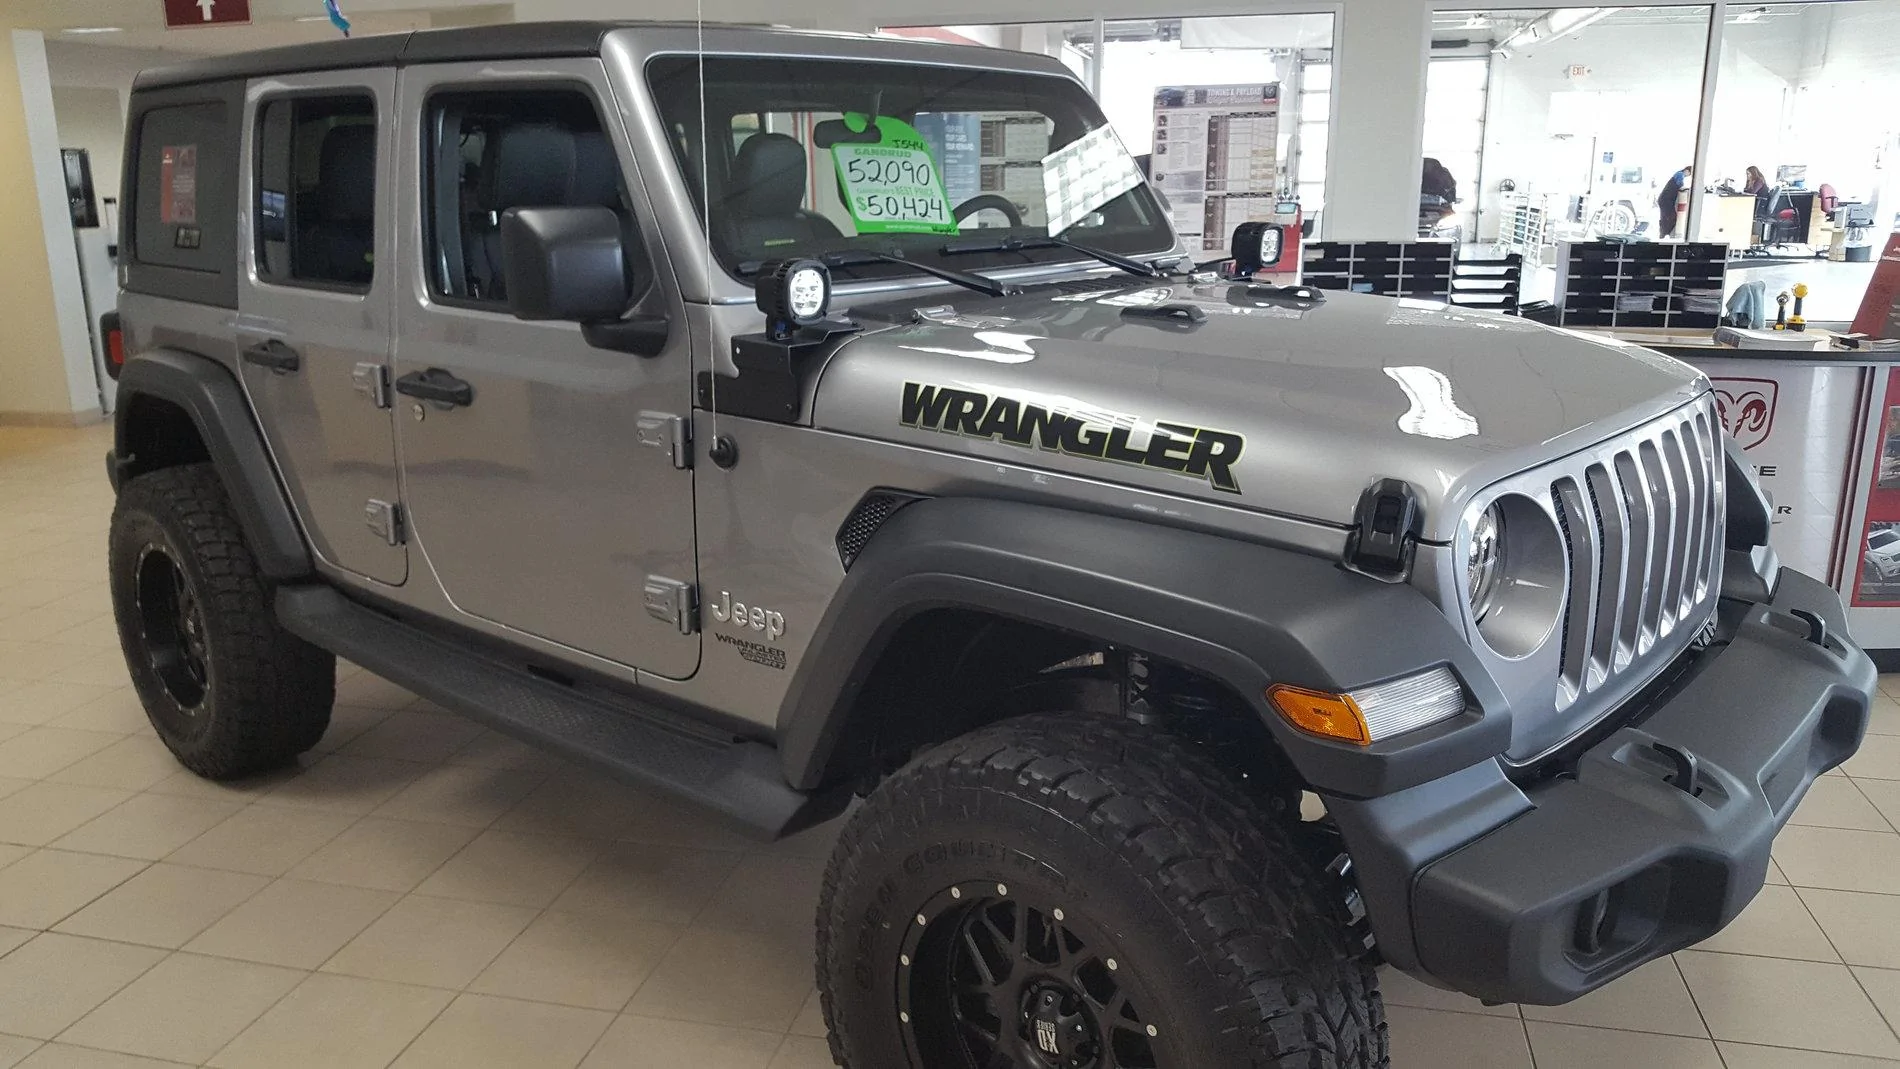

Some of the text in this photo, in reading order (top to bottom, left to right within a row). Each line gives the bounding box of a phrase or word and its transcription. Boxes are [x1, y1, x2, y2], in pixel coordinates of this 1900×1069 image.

[847, 158, 930, 186] 52,090
[900, 380, 1247, 494] WRANGLER
[711, 591, 785, 641] Jeep
[715, 632, 786, 657] WRANGLER
[1037, 1029, 1060, 1055] XD
